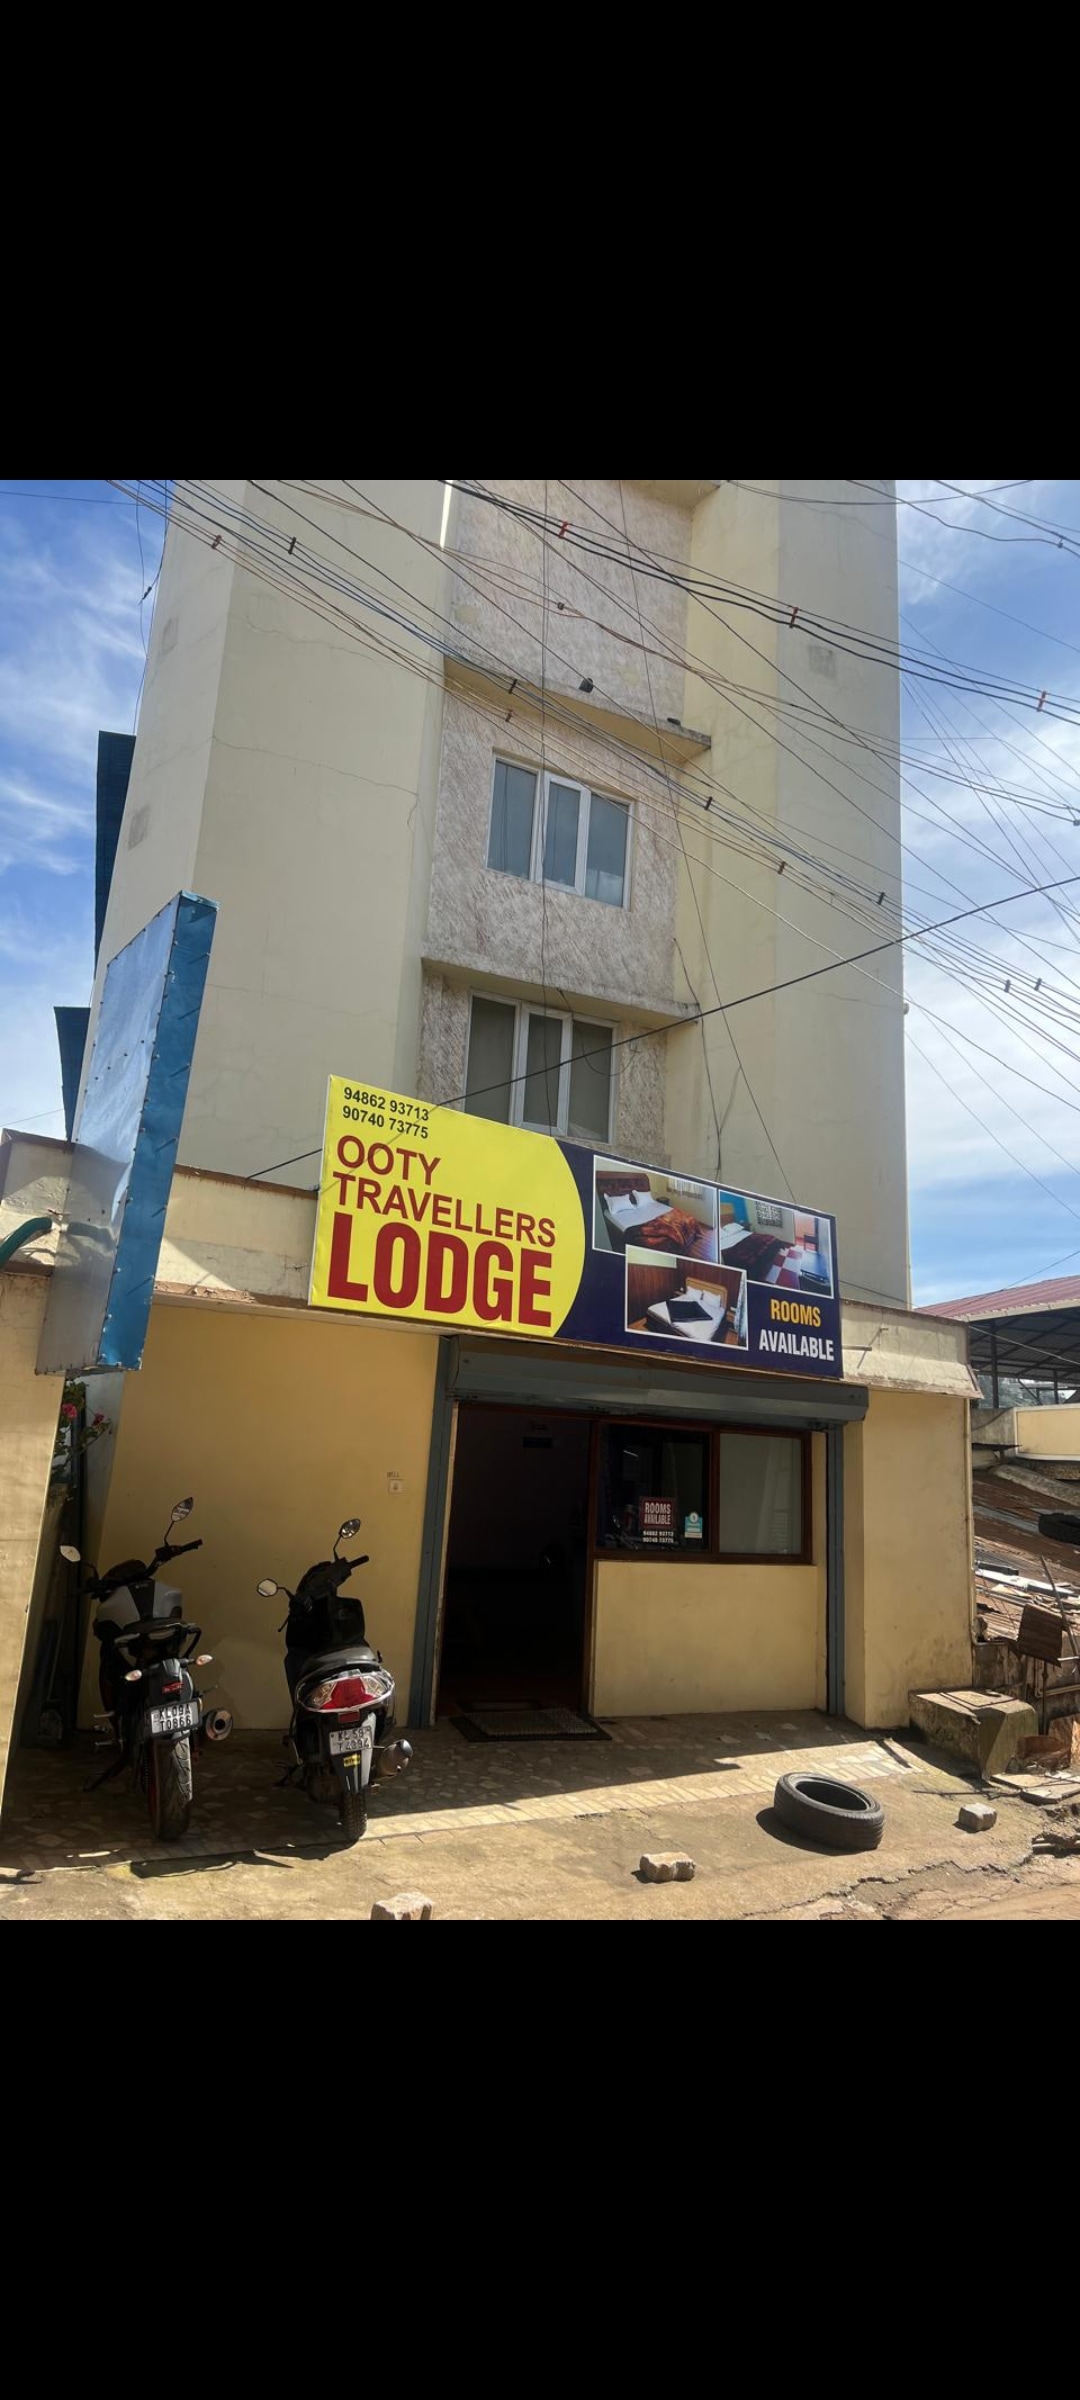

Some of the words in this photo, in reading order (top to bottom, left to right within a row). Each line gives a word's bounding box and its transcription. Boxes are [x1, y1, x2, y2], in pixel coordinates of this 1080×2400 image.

[344, 1087, 386, 1110] 94862
[390, 1100, 429, 1121] 93713
[342, 1105, 385, 1128] 90740
[388, 1117, 429, 1139] 73775
[337, 1134, 441, 1186] OOTY
[332, 1171, 556, 1248] TRAVELLERS
[327, 1211, 552, 1328] LODGE
[770, 1298, 822, 1328] ROOMS
[758, 1328, 835, 1362] AVAILABLE
[645, 1502, 672, 1514] ROOMS
